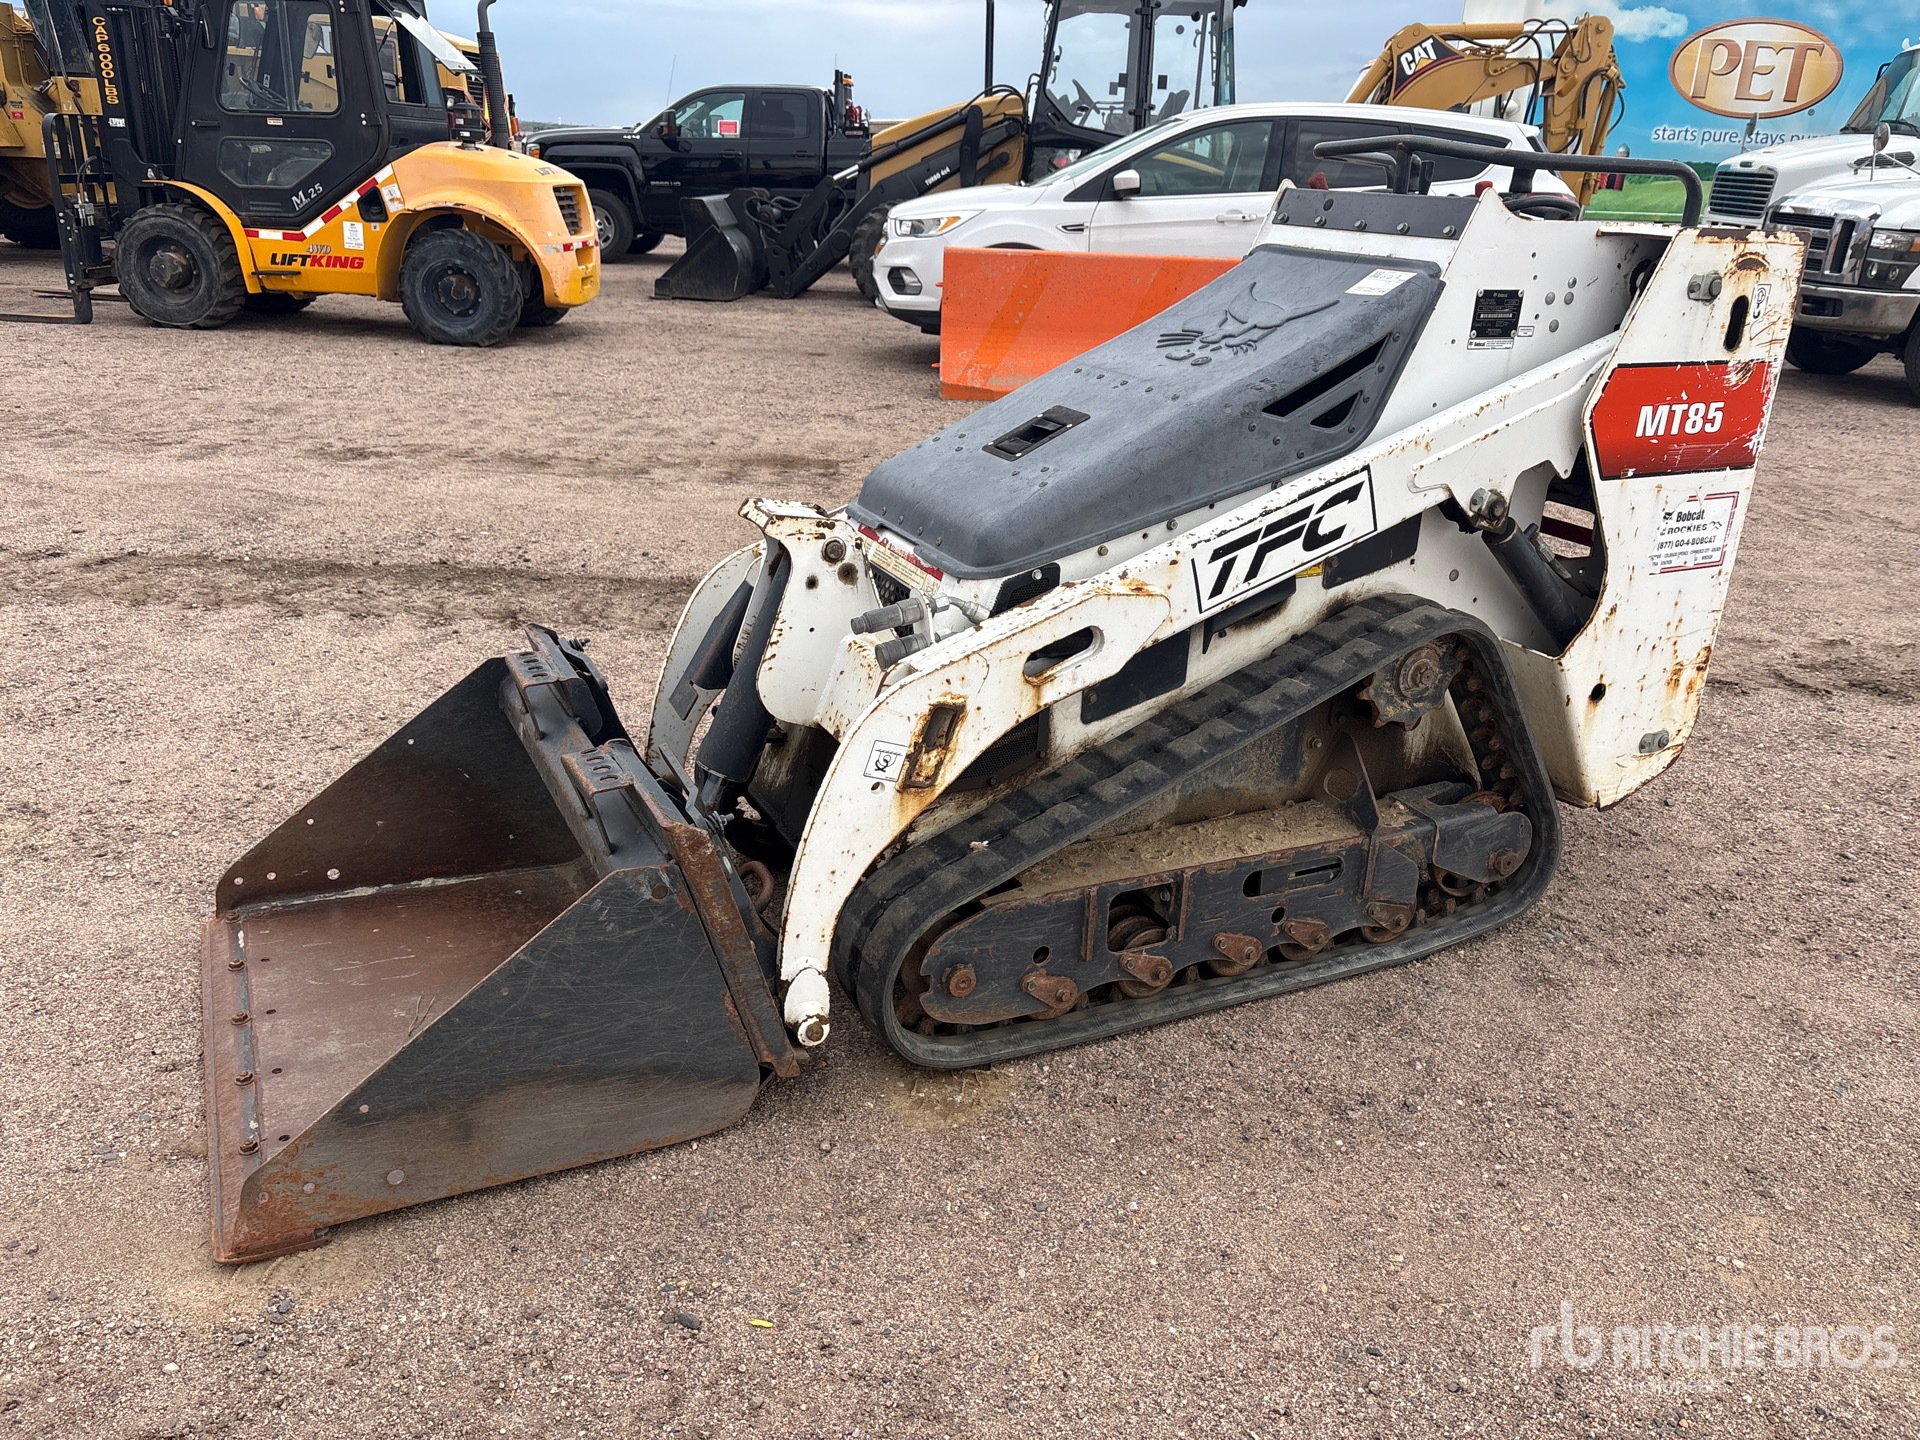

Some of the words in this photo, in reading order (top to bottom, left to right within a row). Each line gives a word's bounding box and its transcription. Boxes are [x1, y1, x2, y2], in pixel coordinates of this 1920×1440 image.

[1400, 37, 1437, 75] CAT
[1690, 38, 1825, 103] PET
[1653, 126, 1697, 142] starts
[1700, 130, 1741, 145] pure.
[1744, 130, 1785, 145] stays
[308, 182, 323, 199] 25
[306, 244, 331, 255] 4WD
[270, 253, 365, 270] LIFTKING
[1635, 401, 1725, 438] MT85
[1675, 510, 1705, 523] Bobcat
[1667, 523, 1708, 535] ROCKIES
[1207, 480, 1365, 600] TFC
[1657, 540, 1674, 551] (877)
